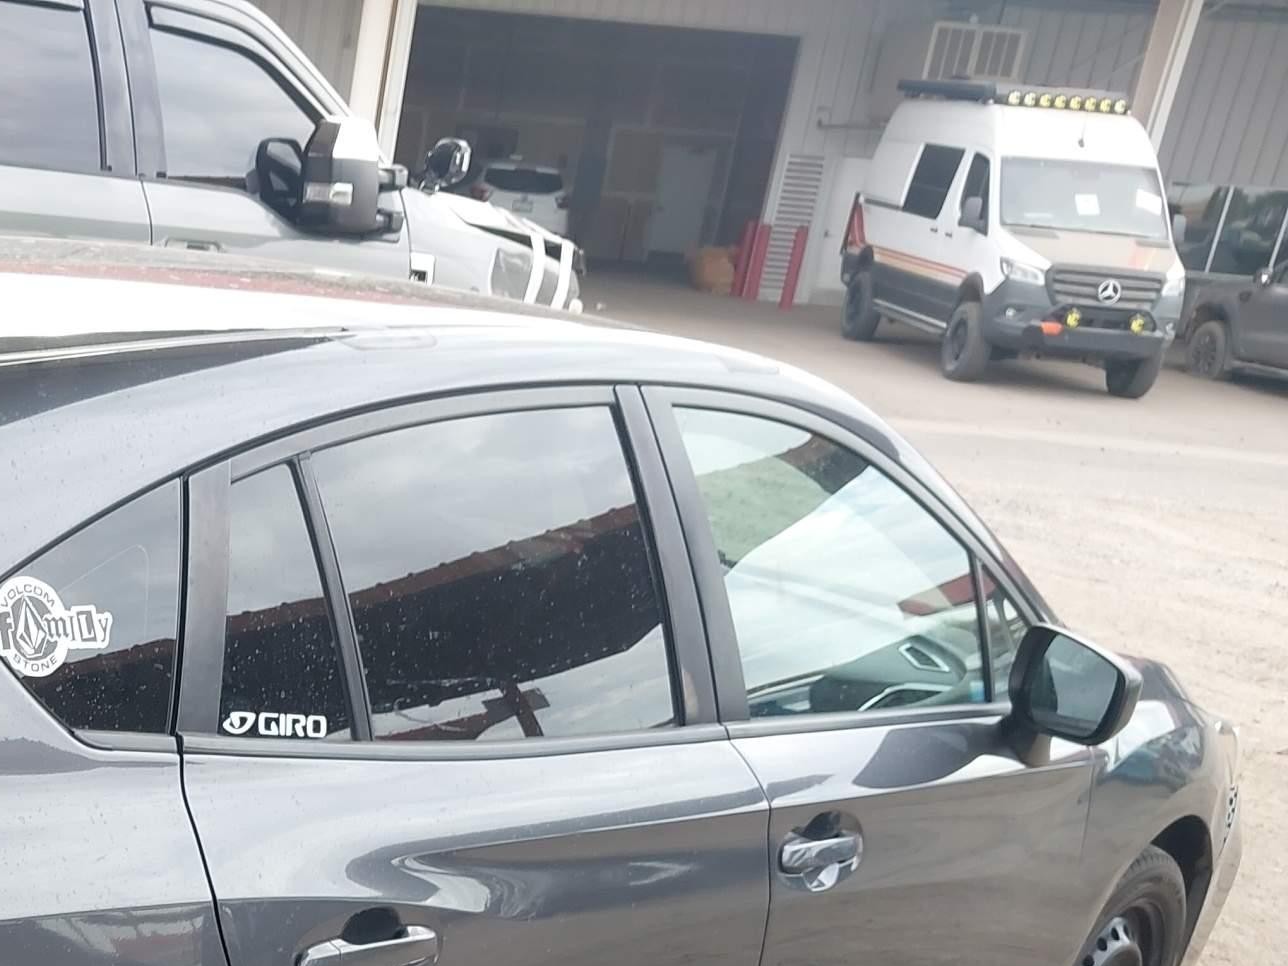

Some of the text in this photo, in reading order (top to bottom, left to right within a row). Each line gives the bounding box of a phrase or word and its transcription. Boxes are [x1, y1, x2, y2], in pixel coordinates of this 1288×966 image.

[0, 583, 56, 609] VOLCOM
[12, 654, 58, 673] STONE
[258, 711, 327, 738] GIRO
